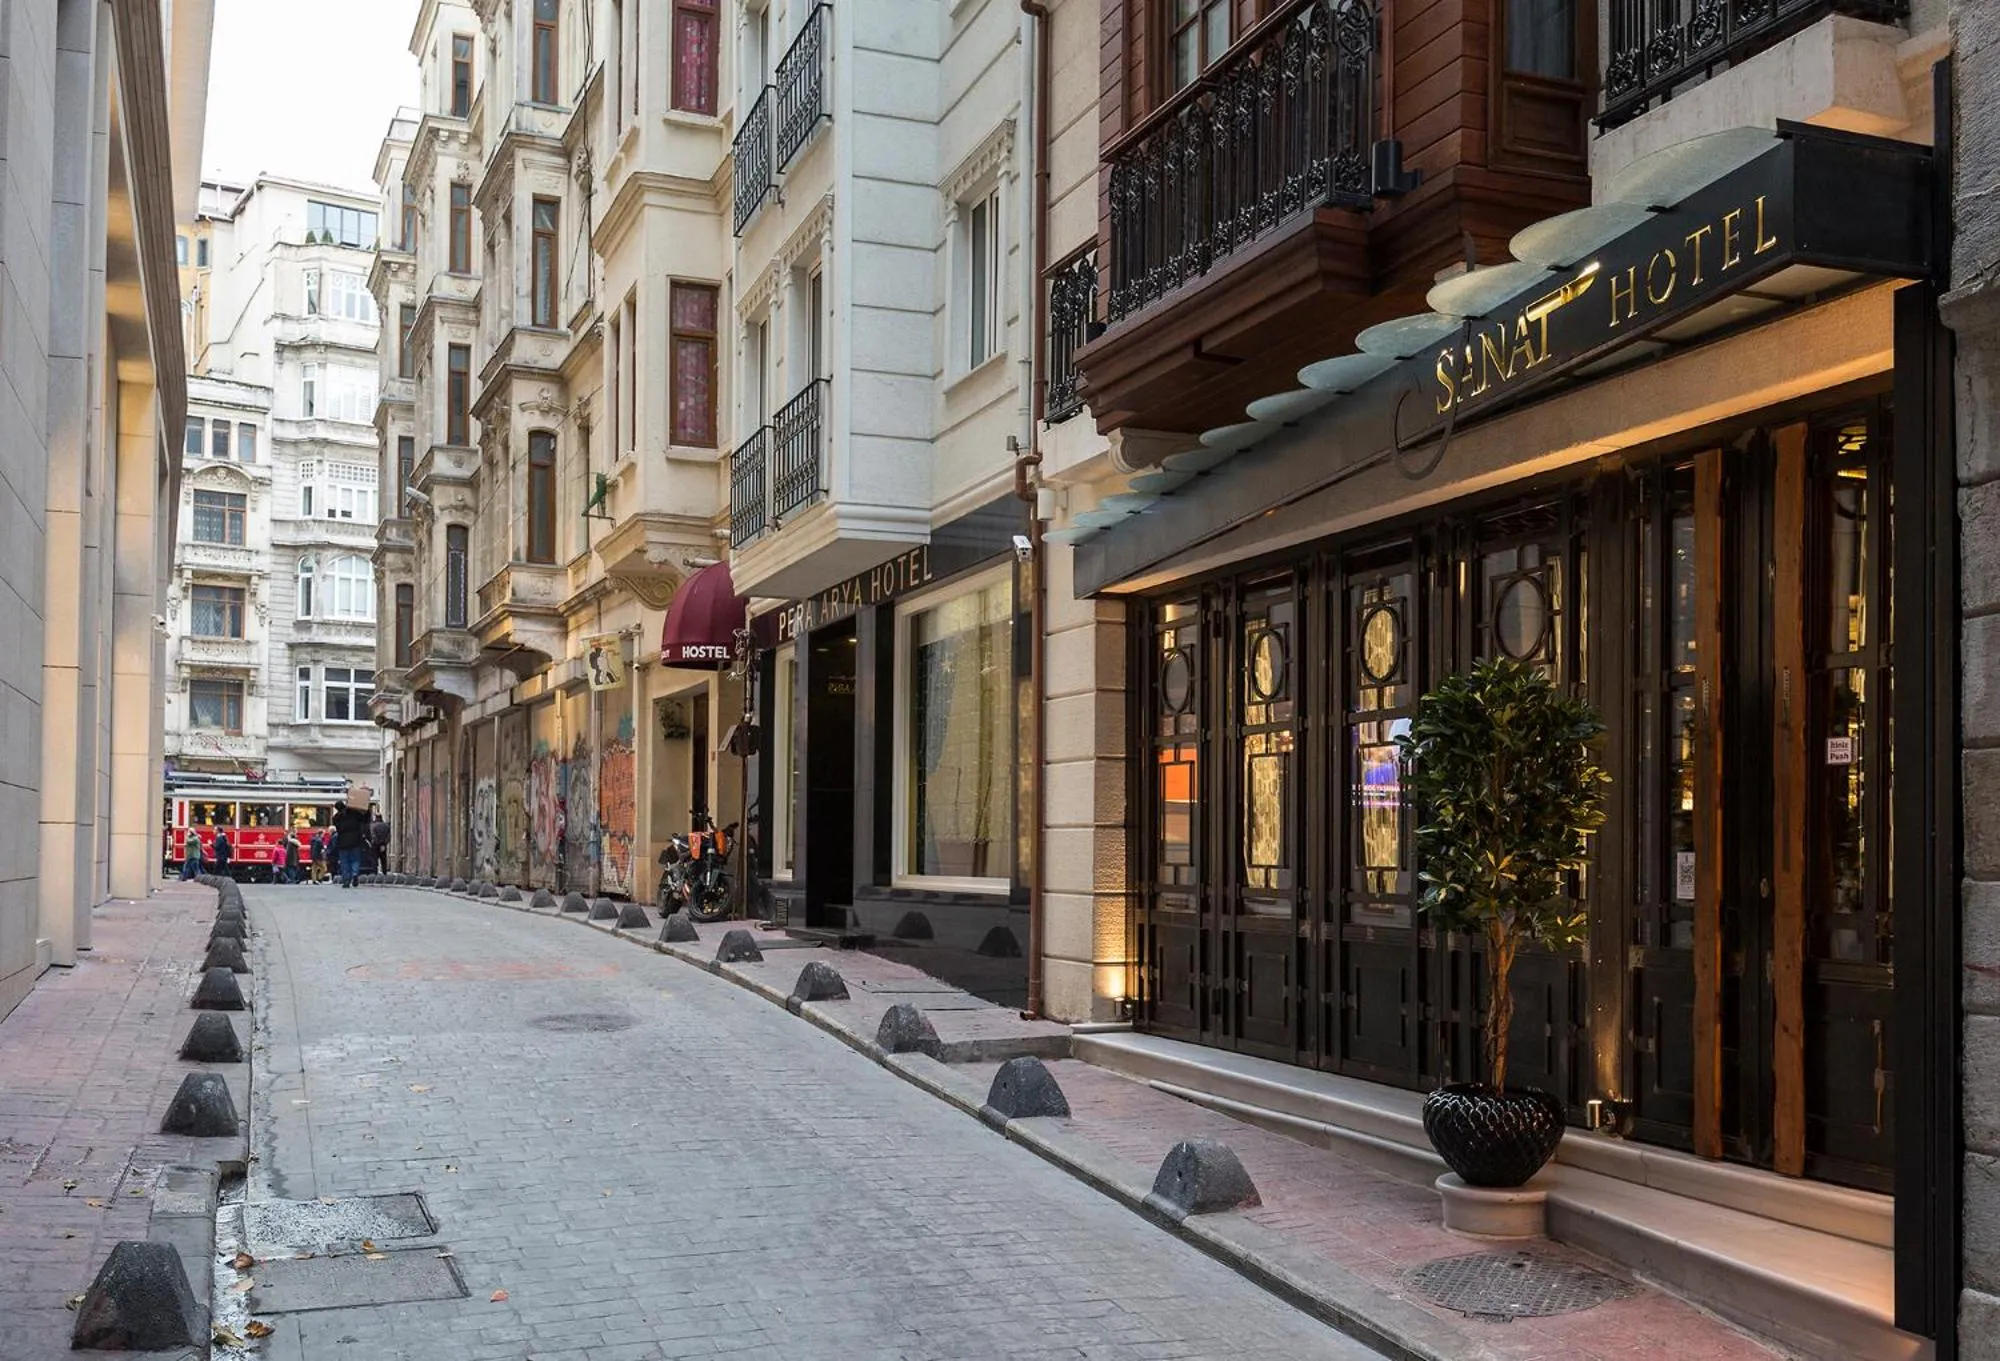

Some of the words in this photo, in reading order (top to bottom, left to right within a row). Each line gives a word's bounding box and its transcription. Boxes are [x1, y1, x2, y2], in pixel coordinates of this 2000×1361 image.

[1436, 261, 1600, 415] SANAT
[1609, 195, 1778, 328] HOTEL
[778, 600, 814, 641] PERA
[820, 576, 863, 623] ARYA
[871, 546, 932, 603] HOTEL
[682, 645, 731, 659] HOSTEL
